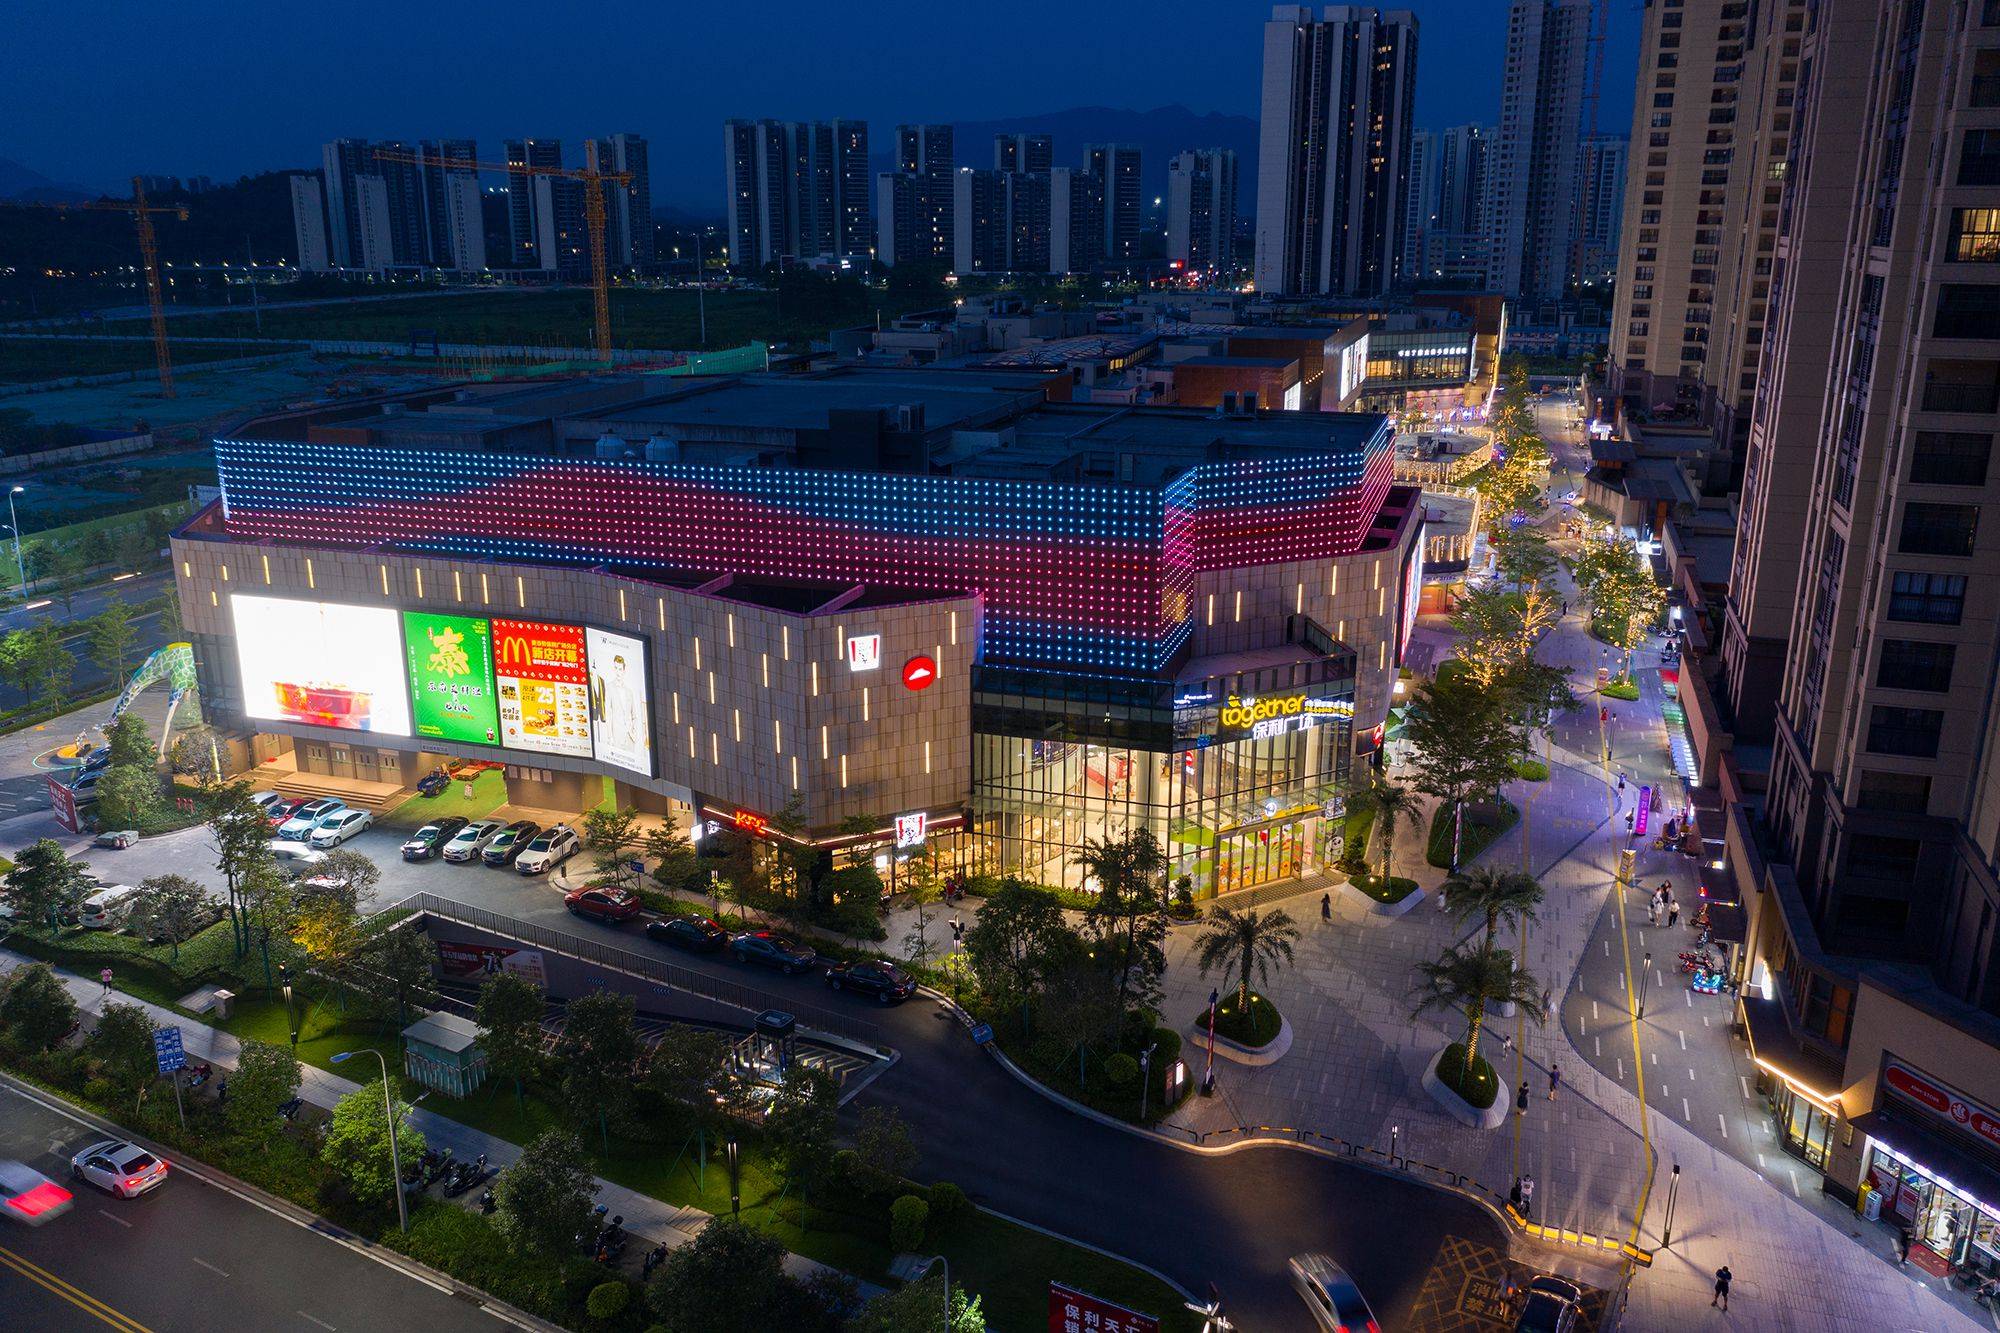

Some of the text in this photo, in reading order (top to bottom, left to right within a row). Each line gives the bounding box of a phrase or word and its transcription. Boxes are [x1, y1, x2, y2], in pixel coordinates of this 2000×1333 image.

[532, 647, 577, 662] 新店开幕
[1222, 695, 1306, 728] together
[1252, 713, 1314, 741] 保利广场
